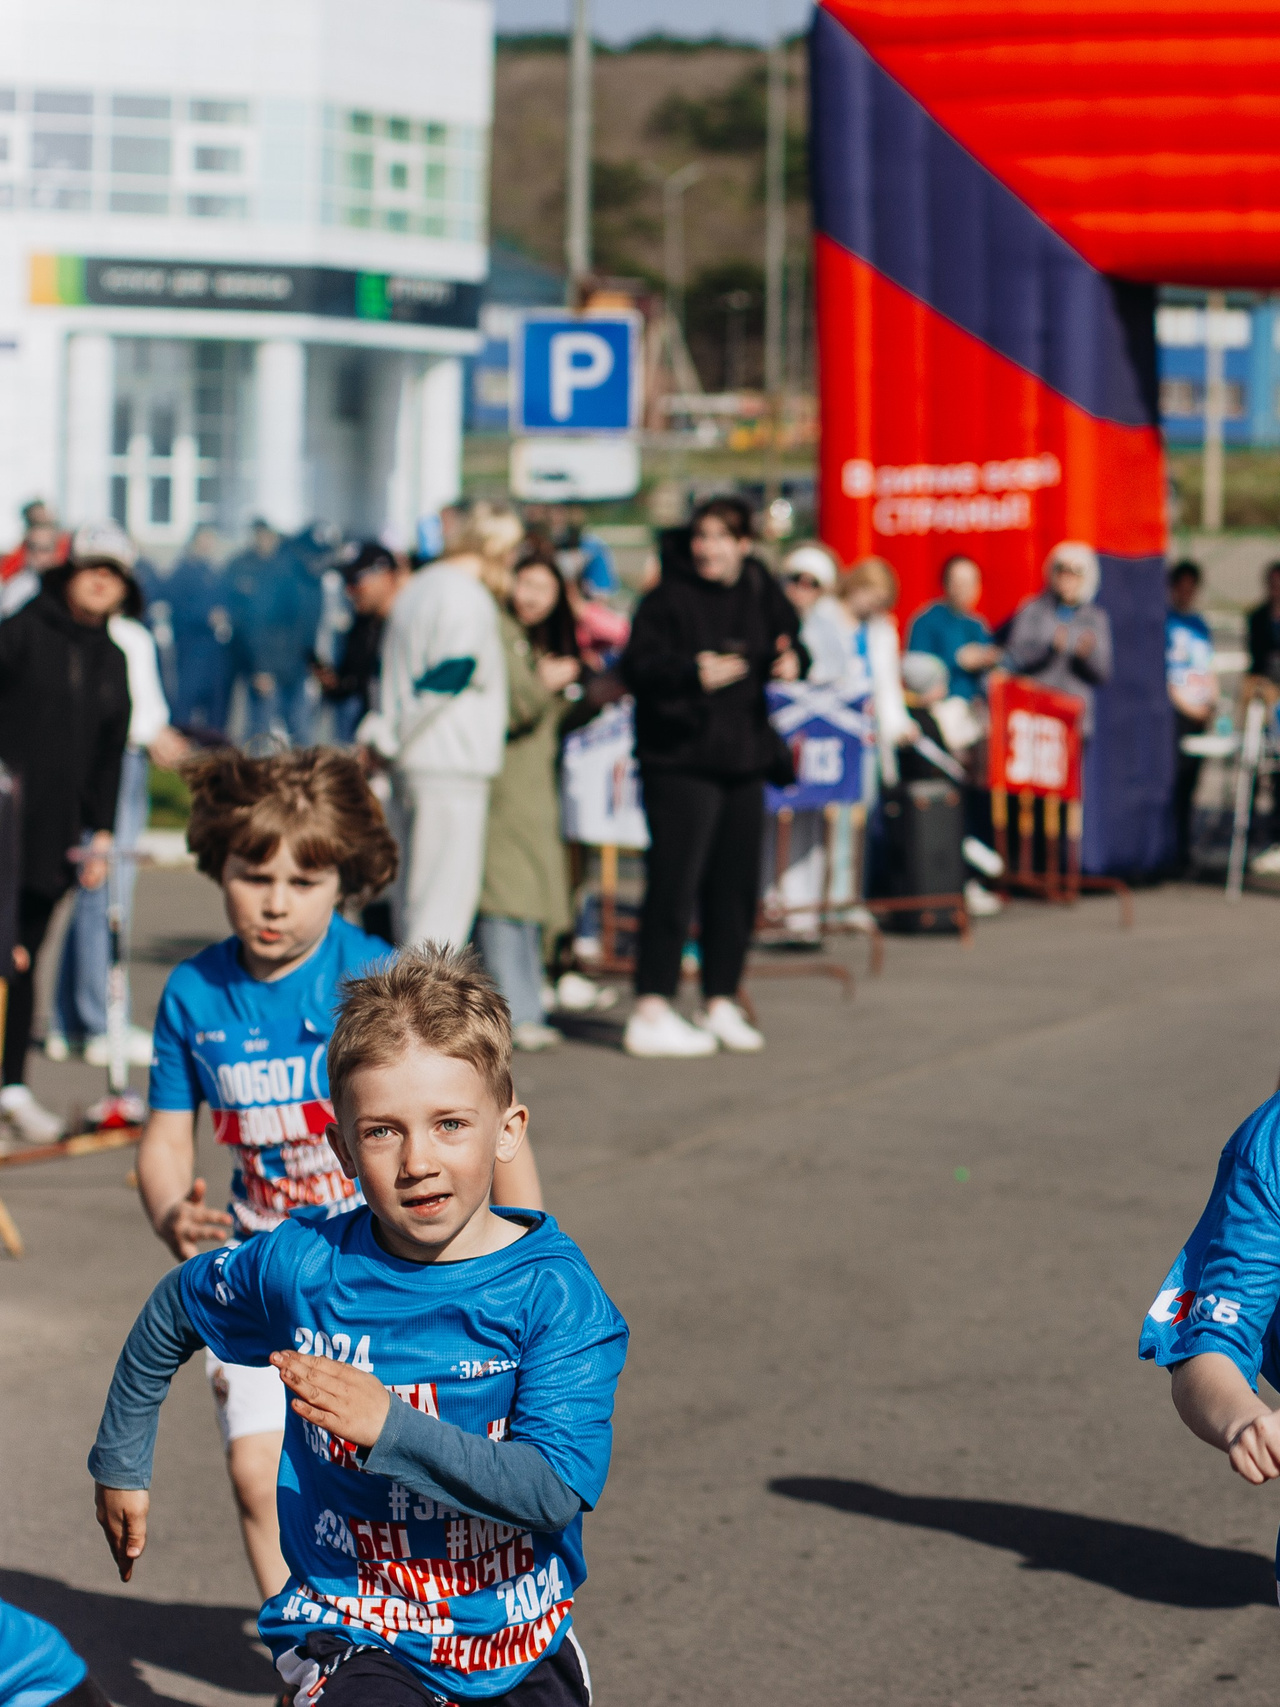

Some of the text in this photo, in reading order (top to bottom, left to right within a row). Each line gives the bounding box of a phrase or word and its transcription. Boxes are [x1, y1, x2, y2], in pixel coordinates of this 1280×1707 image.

[549, 332, 613, 421] P
[217, 1056, 306, 1105] 00507
[497, 1557, 564, 1625] 2024
